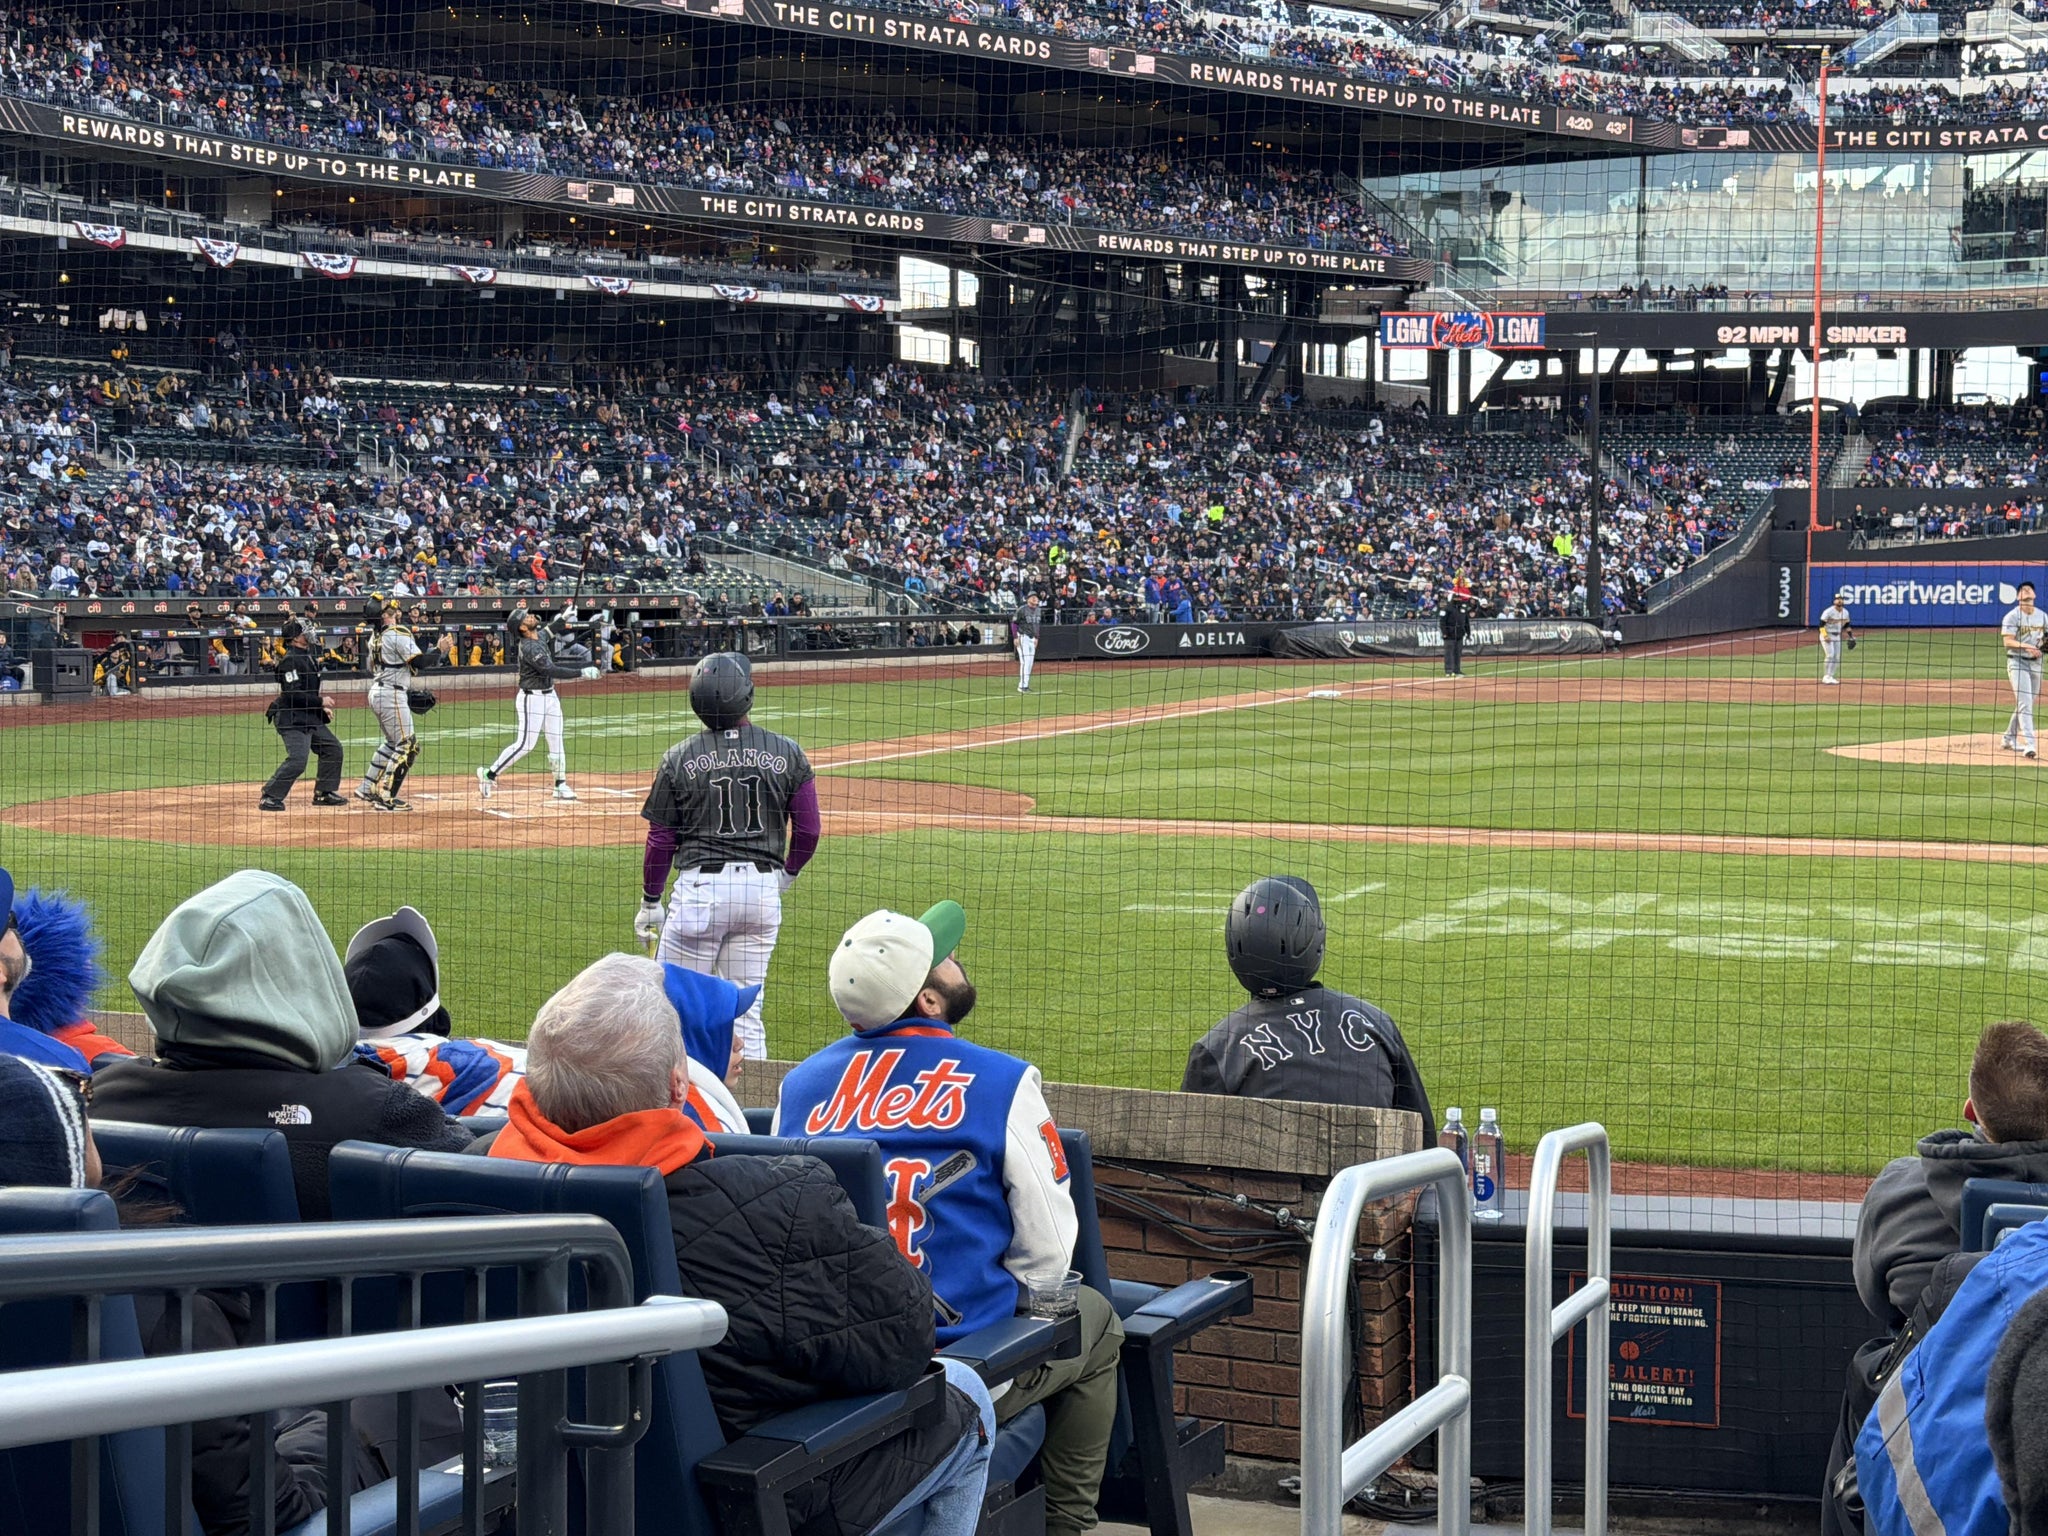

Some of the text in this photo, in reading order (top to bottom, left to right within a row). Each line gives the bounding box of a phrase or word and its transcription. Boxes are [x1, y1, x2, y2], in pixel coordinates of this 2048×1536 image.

[773, 2, 1051, 60] THE CITI STRATA CARDS
[1189, 63, 1541, 125] REWARDS THAT STEP UP TO THE PLATE
[1566, 116, 1593, 132] 4:20
[1605, 121, 1627, 135] 43°
[1834, 130, 1877, 147] THE
[1886, 130, 1930, 147] CITI
[1940, 127, 2029, 146] STRATA
[63, 115, 477, 189] REWARDS THAT STEP UP TO THE PLATE
[701, 196, 925, 232] THE CITI STRATA CARDS
[1098, 234, 1386, 273] REWARDS THAT STEP UP TO THE PLATE
[1387, 317, 1428, 343] LGM
[1442, 322, 1482, 343] Mets
[1498, 317, 1539, 343] LGM
[1718, 326, 1907, 344] 92 MPH SINKER
[1839, 580, 1994, 605] smartwater
[1105, 631, 1141, 650] Ford
[1196, 632, 1246, 646] DELTA
[683, 748, 787, 780] POLANCO
[709, 775, 765, 836] 11
[1240, 1009, 1376, 1071] NYC
[805, 1048, 976, 1136] Mets
[281, 1104, 299, 1112] THE
[1610, 1283, 1694, 1302] AUTION!
[1610, 1313, 1620, 1322] HE
[1623, 1314, 1670, 1325] PROTECTIVE
[1618, 1303, 1638, 1312] KEEP
[1641, 1305, 1662, 1314] YOUR
[1665, 1306, 1703, 1317] DISTANCE
[1623, 1365, 1695, 1384] ALERT!
[1618, 1393, 1632, 1402] THE
[1634, 1394, 1668, 1404] PLAYING
[1632, 1384, 1666, 1394] OBJECTS
[1668, 1386, 1685, 1396] MAY
